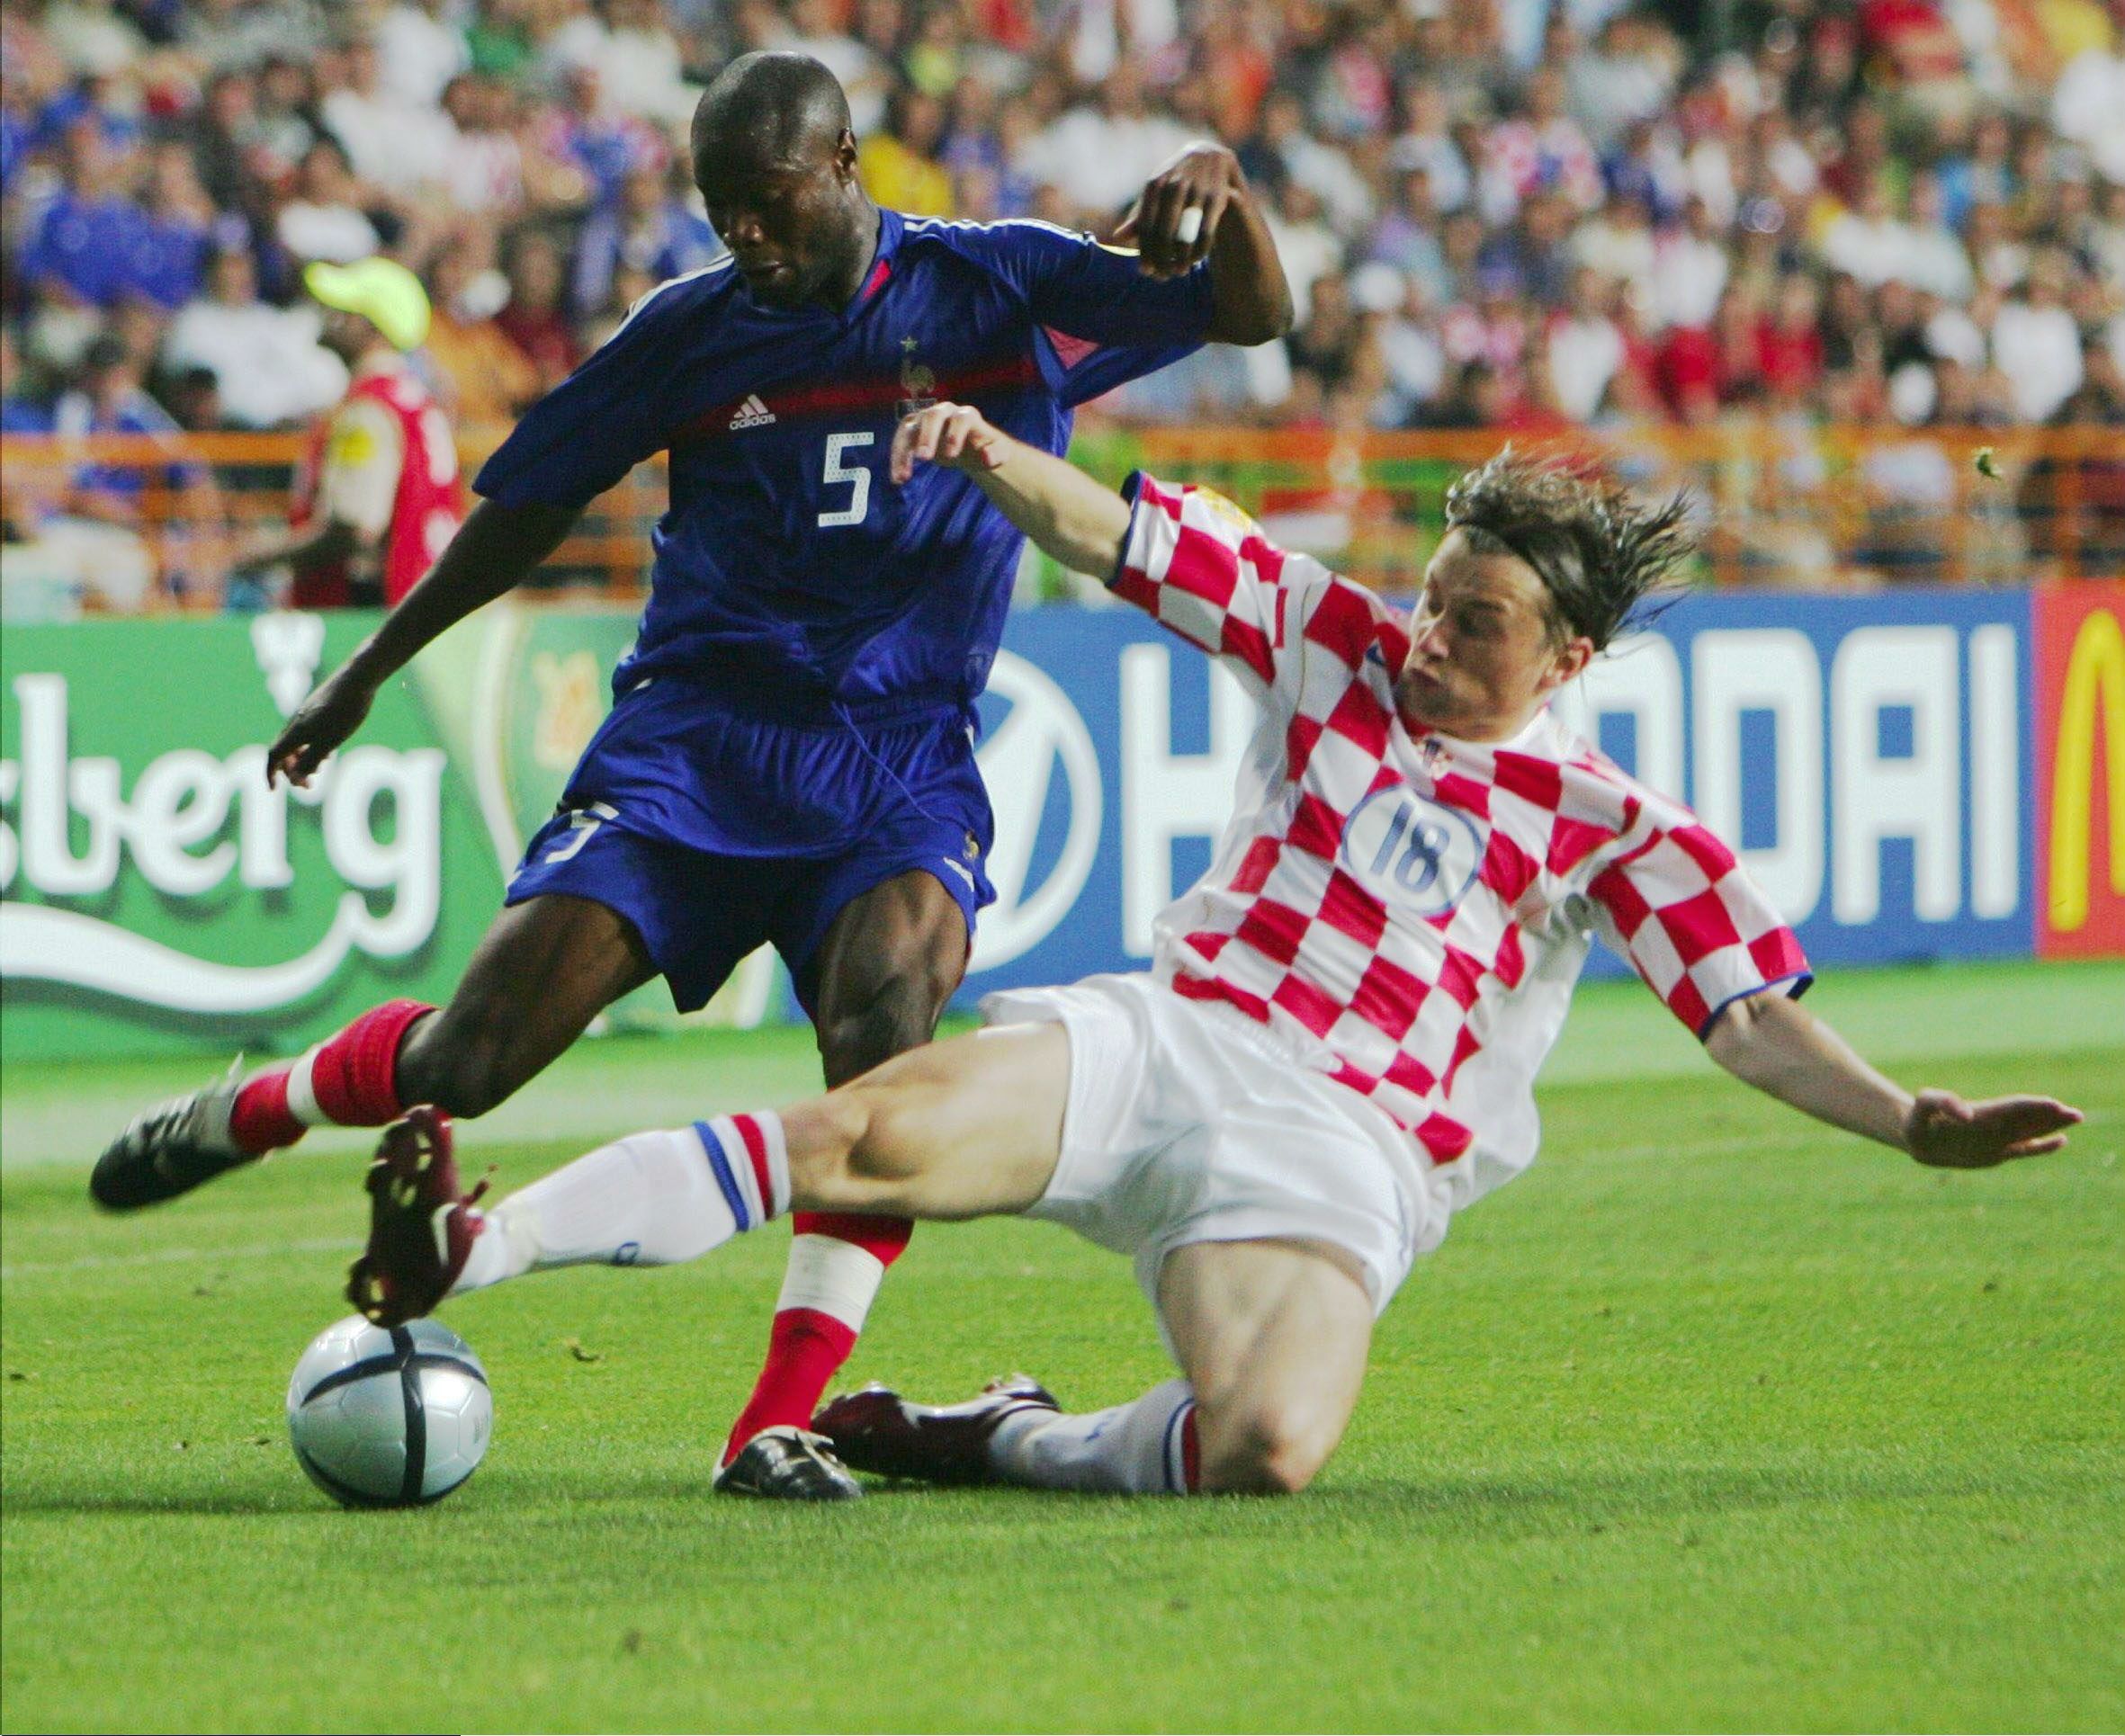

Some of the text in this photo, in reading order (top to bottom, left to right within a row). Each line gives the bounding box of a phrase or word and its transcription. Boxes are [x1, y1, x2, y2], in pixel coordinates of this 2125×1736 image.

[818, 431, 874, 528] 5
[0, 672, 448, 958] berg
[1368, 800, 1451, 893] 18
